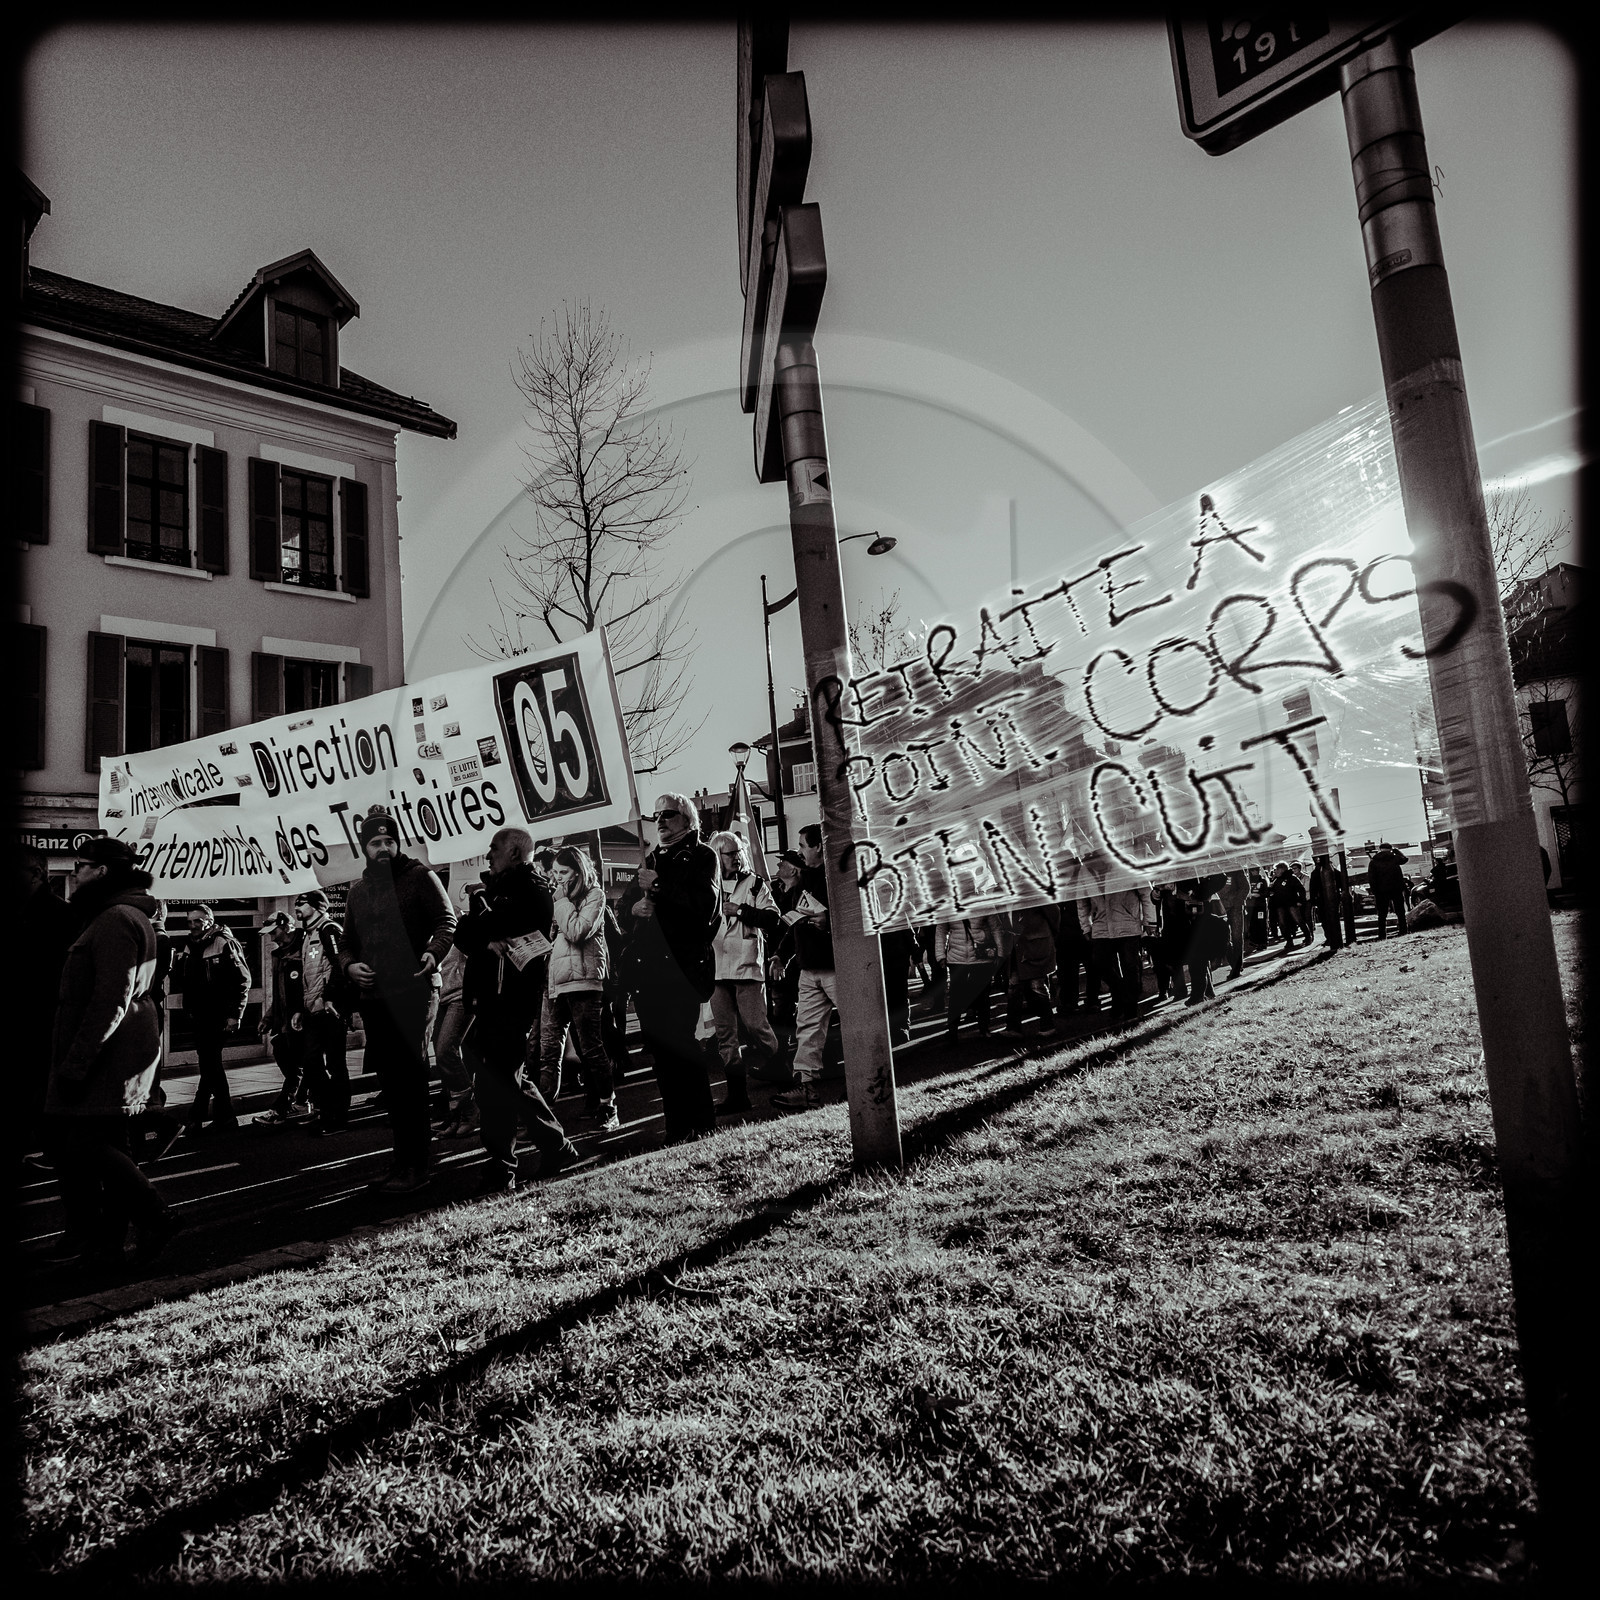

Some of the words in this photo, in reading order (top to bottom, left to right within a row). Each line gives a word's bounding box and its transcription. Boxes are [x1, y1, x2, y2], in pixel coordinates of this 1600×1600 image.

[1232, 31, 1276, 74] 19
[1084, 552, 1478, 741] CORPS
[249, 718, 398, 798] Direction
[450, 765, 458, 775] JE
[458, 760, 478, 773] LUTTE
[513, 668, 589, 804] 05
[275, 815, 329, 873] des
[839, 805, 1058, 928] BIEN
[1091, 716, 1347, 871] CUIT
